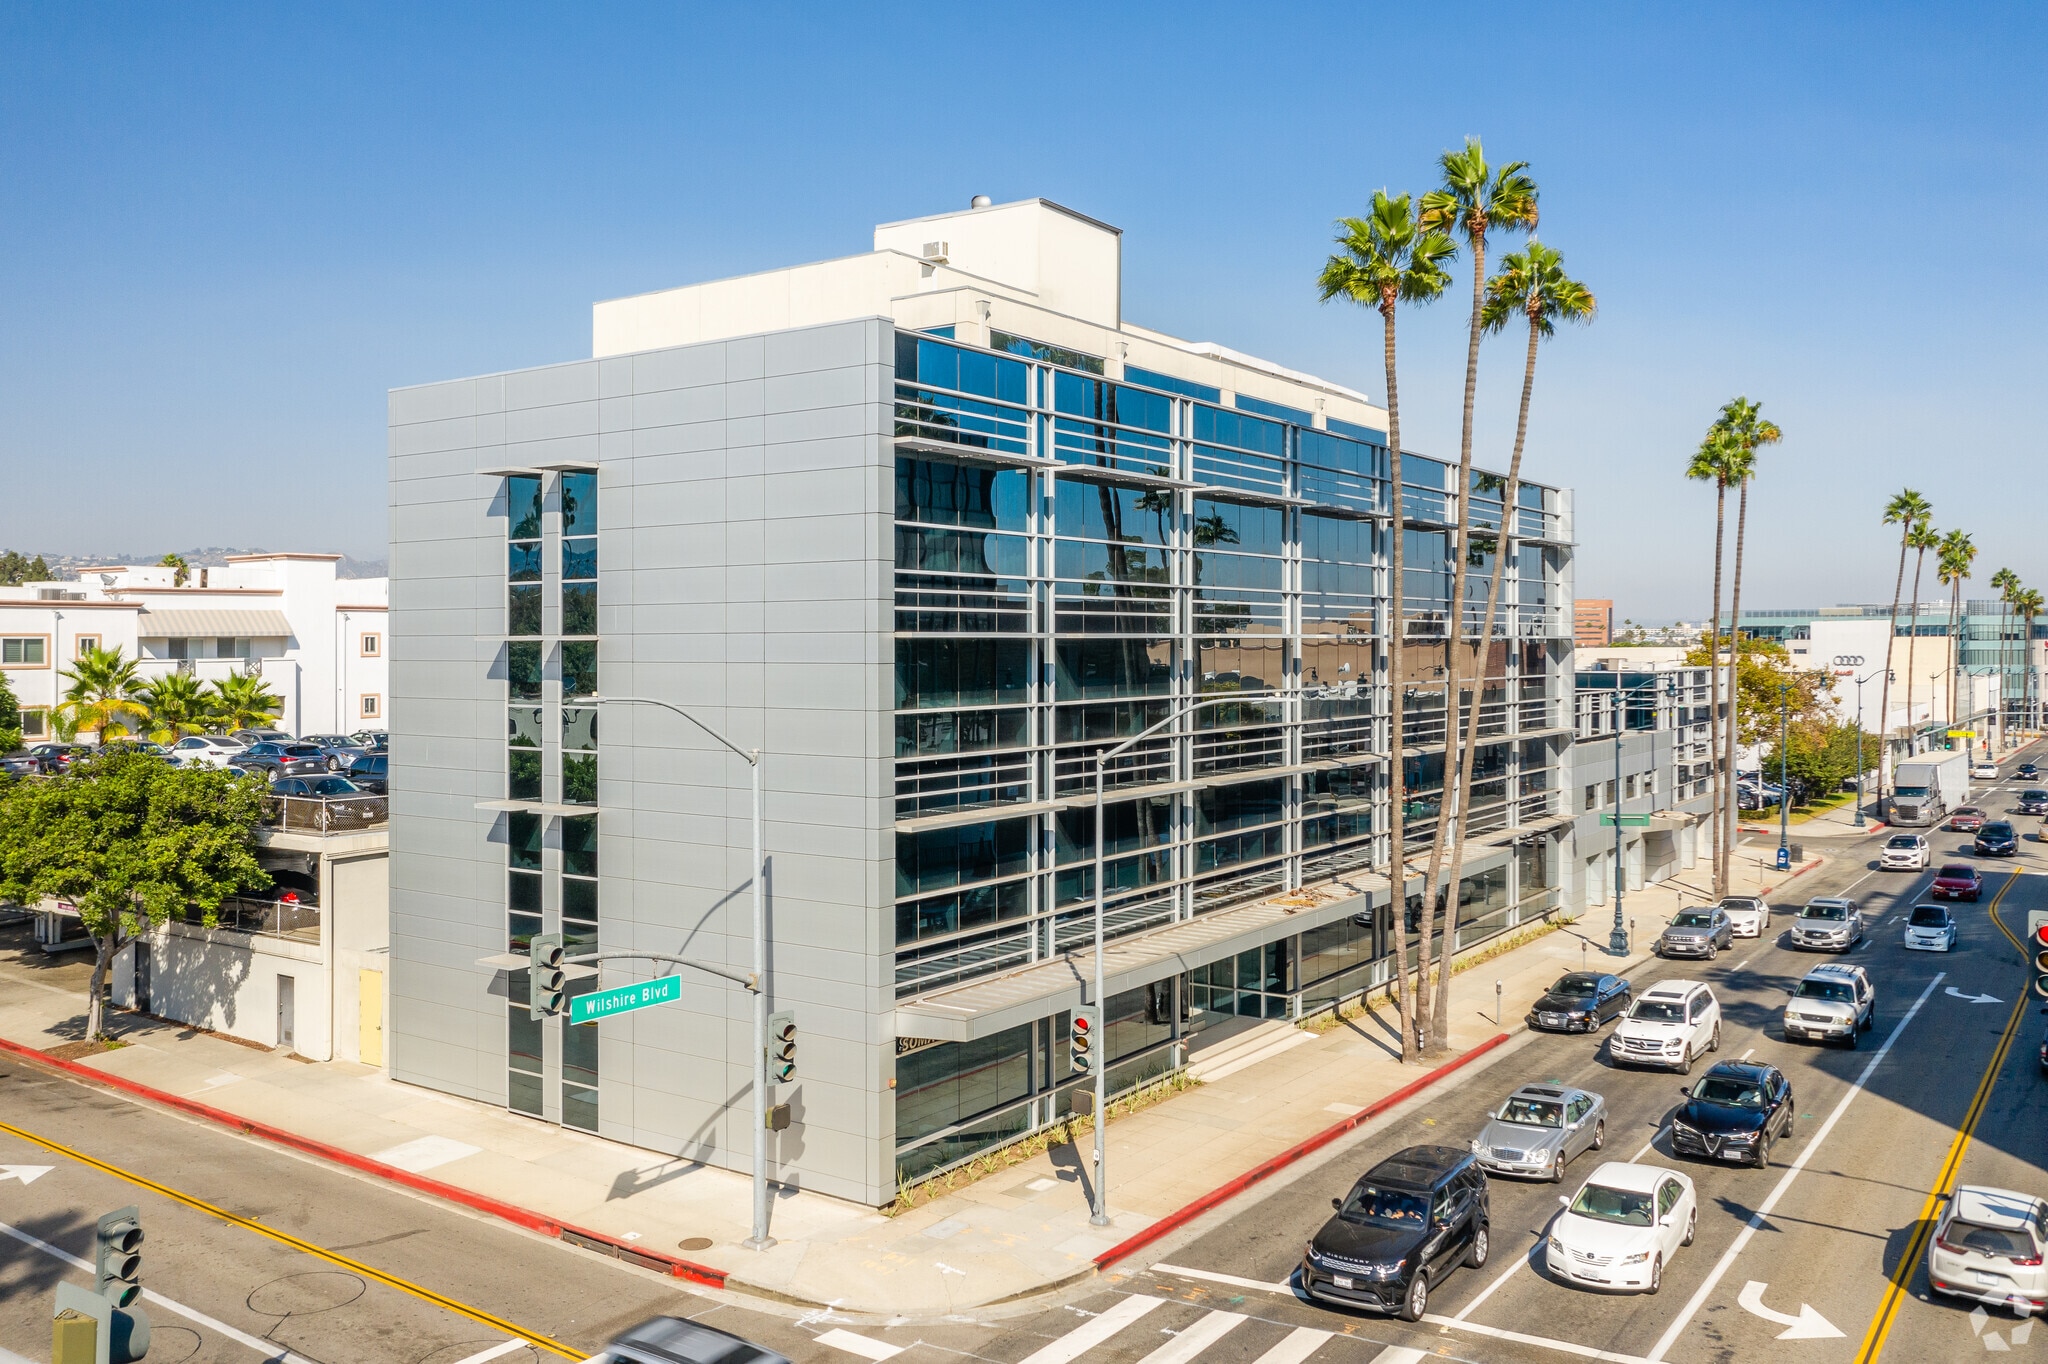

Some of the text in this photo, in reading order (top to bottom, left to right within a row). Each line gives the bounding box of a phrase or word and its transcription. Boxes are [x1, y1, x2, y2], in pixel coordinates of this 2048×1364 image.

[586, 983, 669, 1015] Wilshire Blvd
[1326, 1251, 1370, 1264] DISCOVERY
